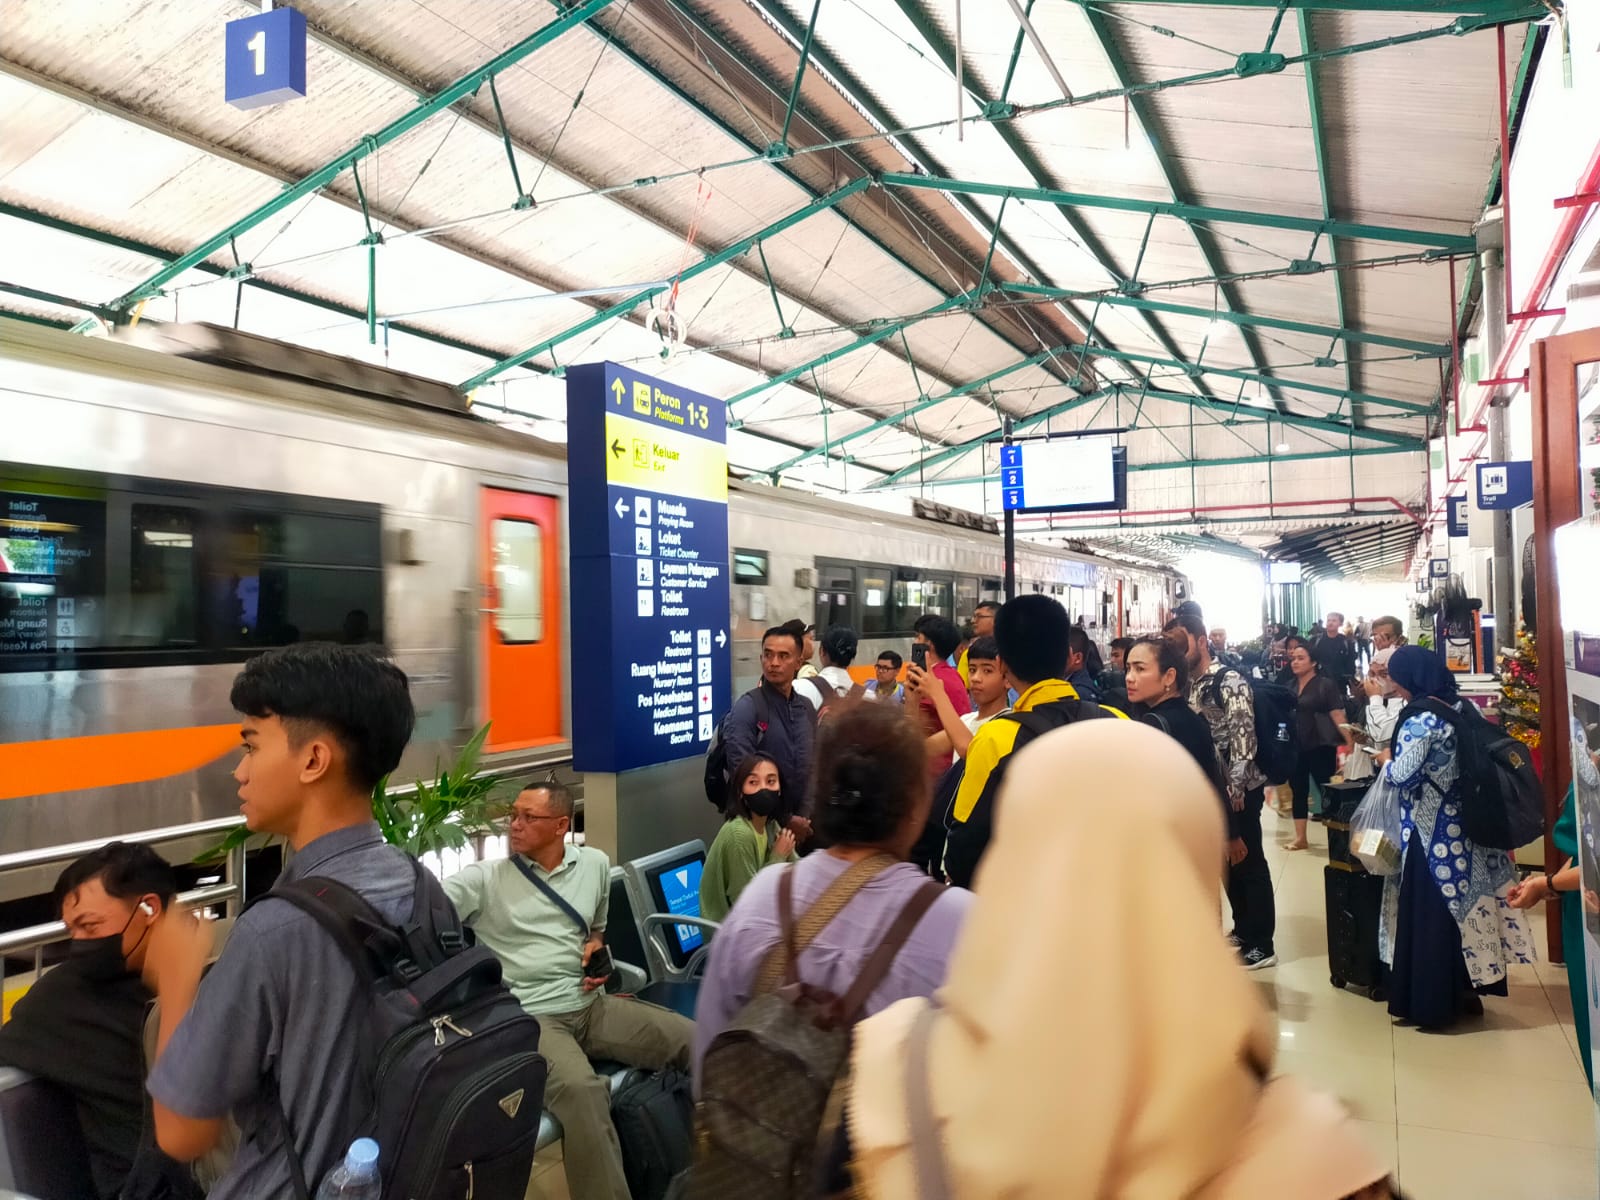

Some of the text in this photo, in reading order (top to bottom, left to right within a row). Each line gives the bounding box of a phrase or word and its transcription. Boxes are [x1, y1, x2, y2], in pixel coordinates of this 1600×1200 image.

[247, 30, 266, 76] 1
[654, 387, 680, 410] Peron
[653, 443, 680, 461] Keluar
[1009, 454, 1015, 464] 1
[1009, 475, 1017, 485] 2
[1010, 495, 1018, 505] 3
[658, 530, 681, 546] Loket
[659, 546, 676, 557] Ticket
[660, 589, 683, 603] Toilet
[661, 605, 689, 616] Restroom
[670, 629, 692, 643] Toilet
[664, 646, 692, 657] Restroom
[631, 662, 656, 678] Ruang
[638, 690, 694, 708] Pos Kesehatan
[654, 719, 694, 735] Keamanan
[670, 731, 693, 745] Security
